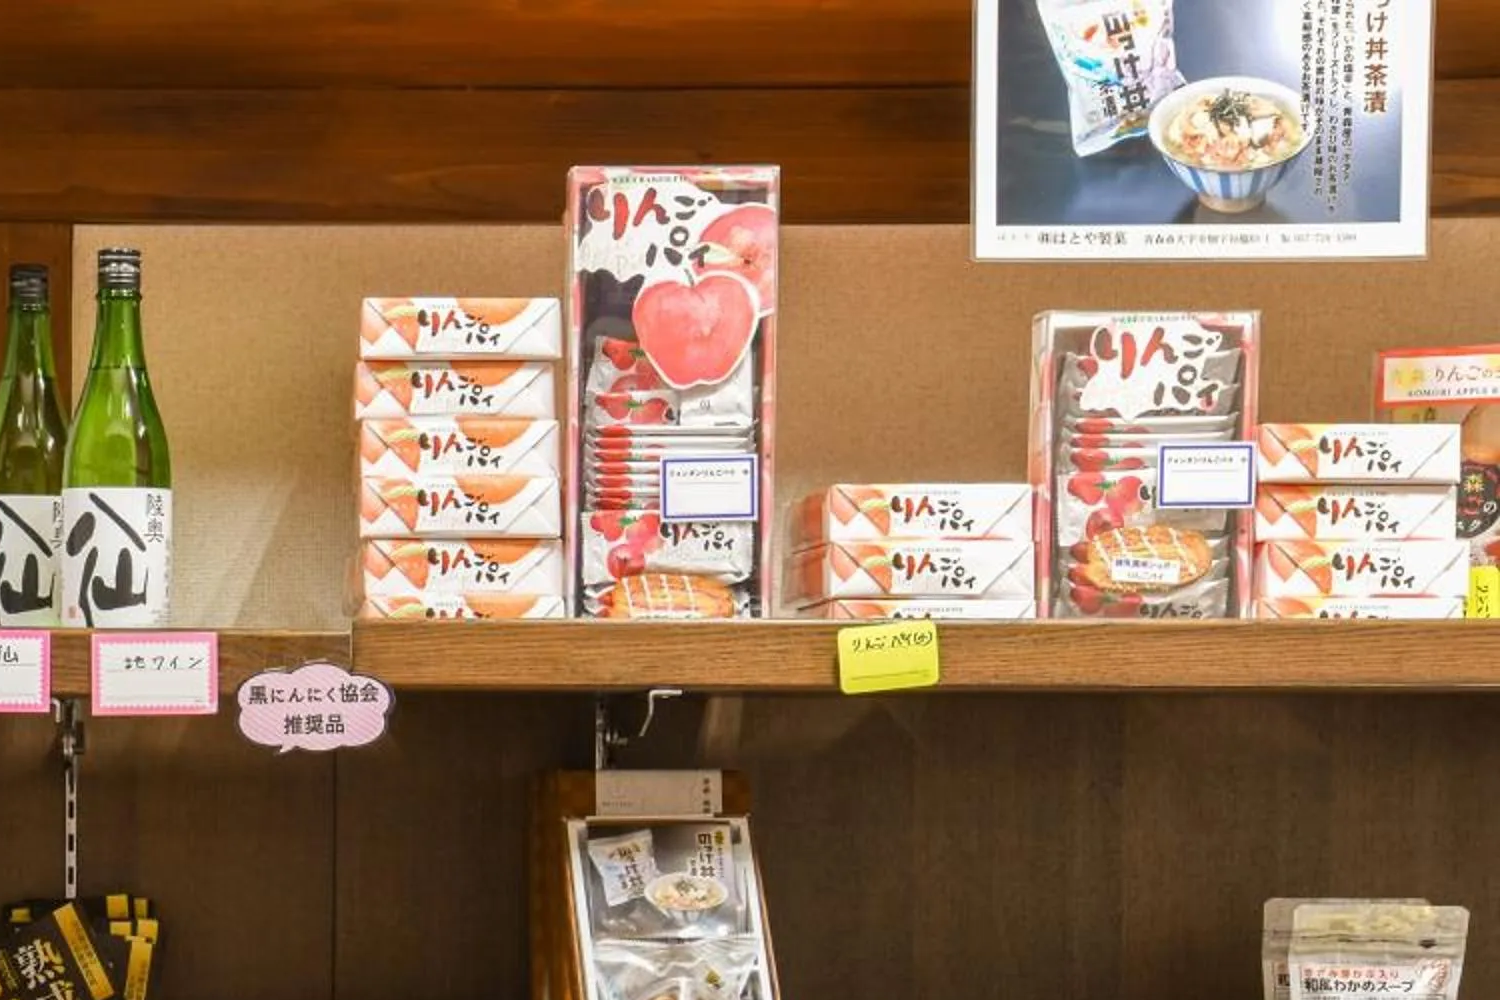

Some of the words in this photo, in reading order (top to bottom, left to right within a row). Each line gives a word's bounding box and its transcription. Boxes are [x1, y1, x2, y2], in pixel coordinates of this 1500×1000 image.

[66, 492, 148, 627] 八仙
[248, 683, 379, 705] 黒にんにく協会
[284, 714, 345, 735] 推奨品
[1304, 977, 1414, 994] 和風わかめスープ
